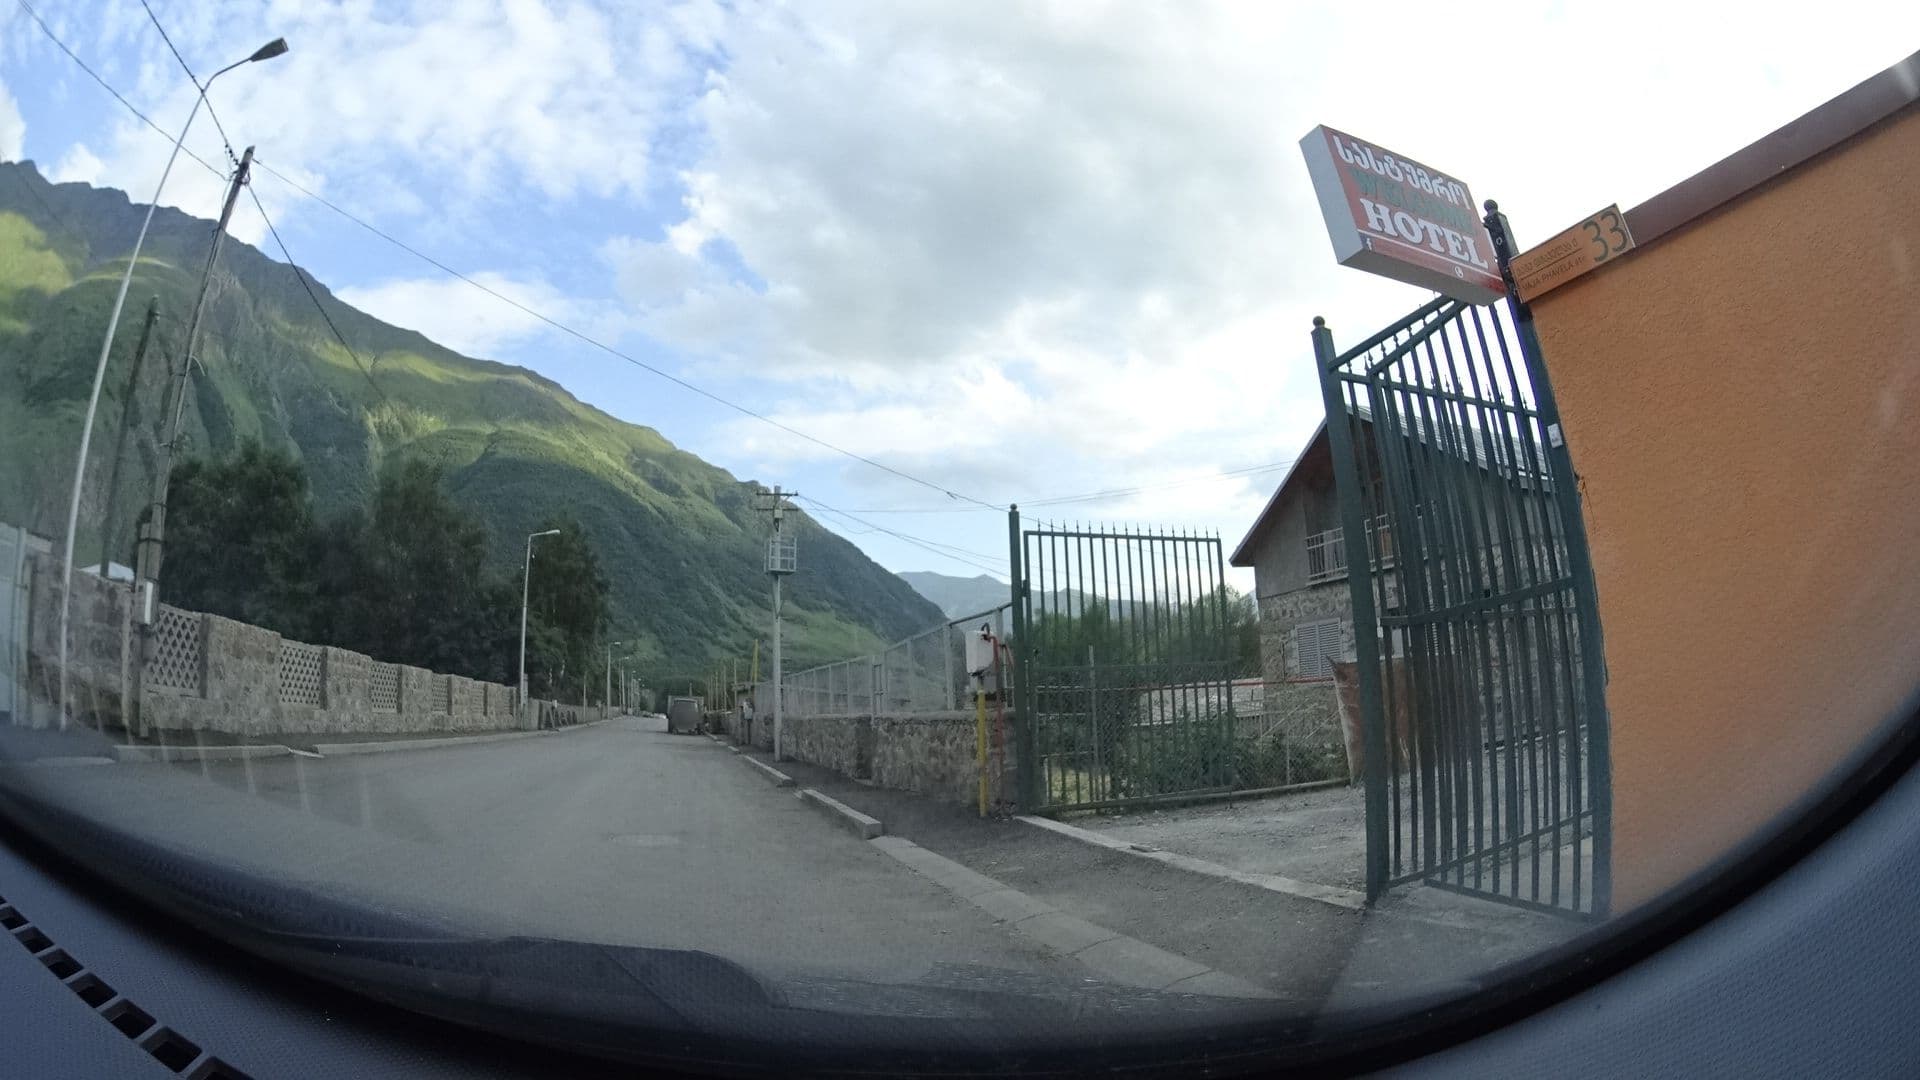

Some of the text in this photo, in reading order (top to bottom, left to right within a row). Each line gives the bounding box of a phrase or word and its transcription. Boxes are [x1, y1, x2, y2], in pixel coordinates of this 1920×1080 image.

[1333, 135, 1471, 210] სასტუმრო
[1360, 198, 1488, 269] HOTEL
[1582, 210, 1628, 263] 33
